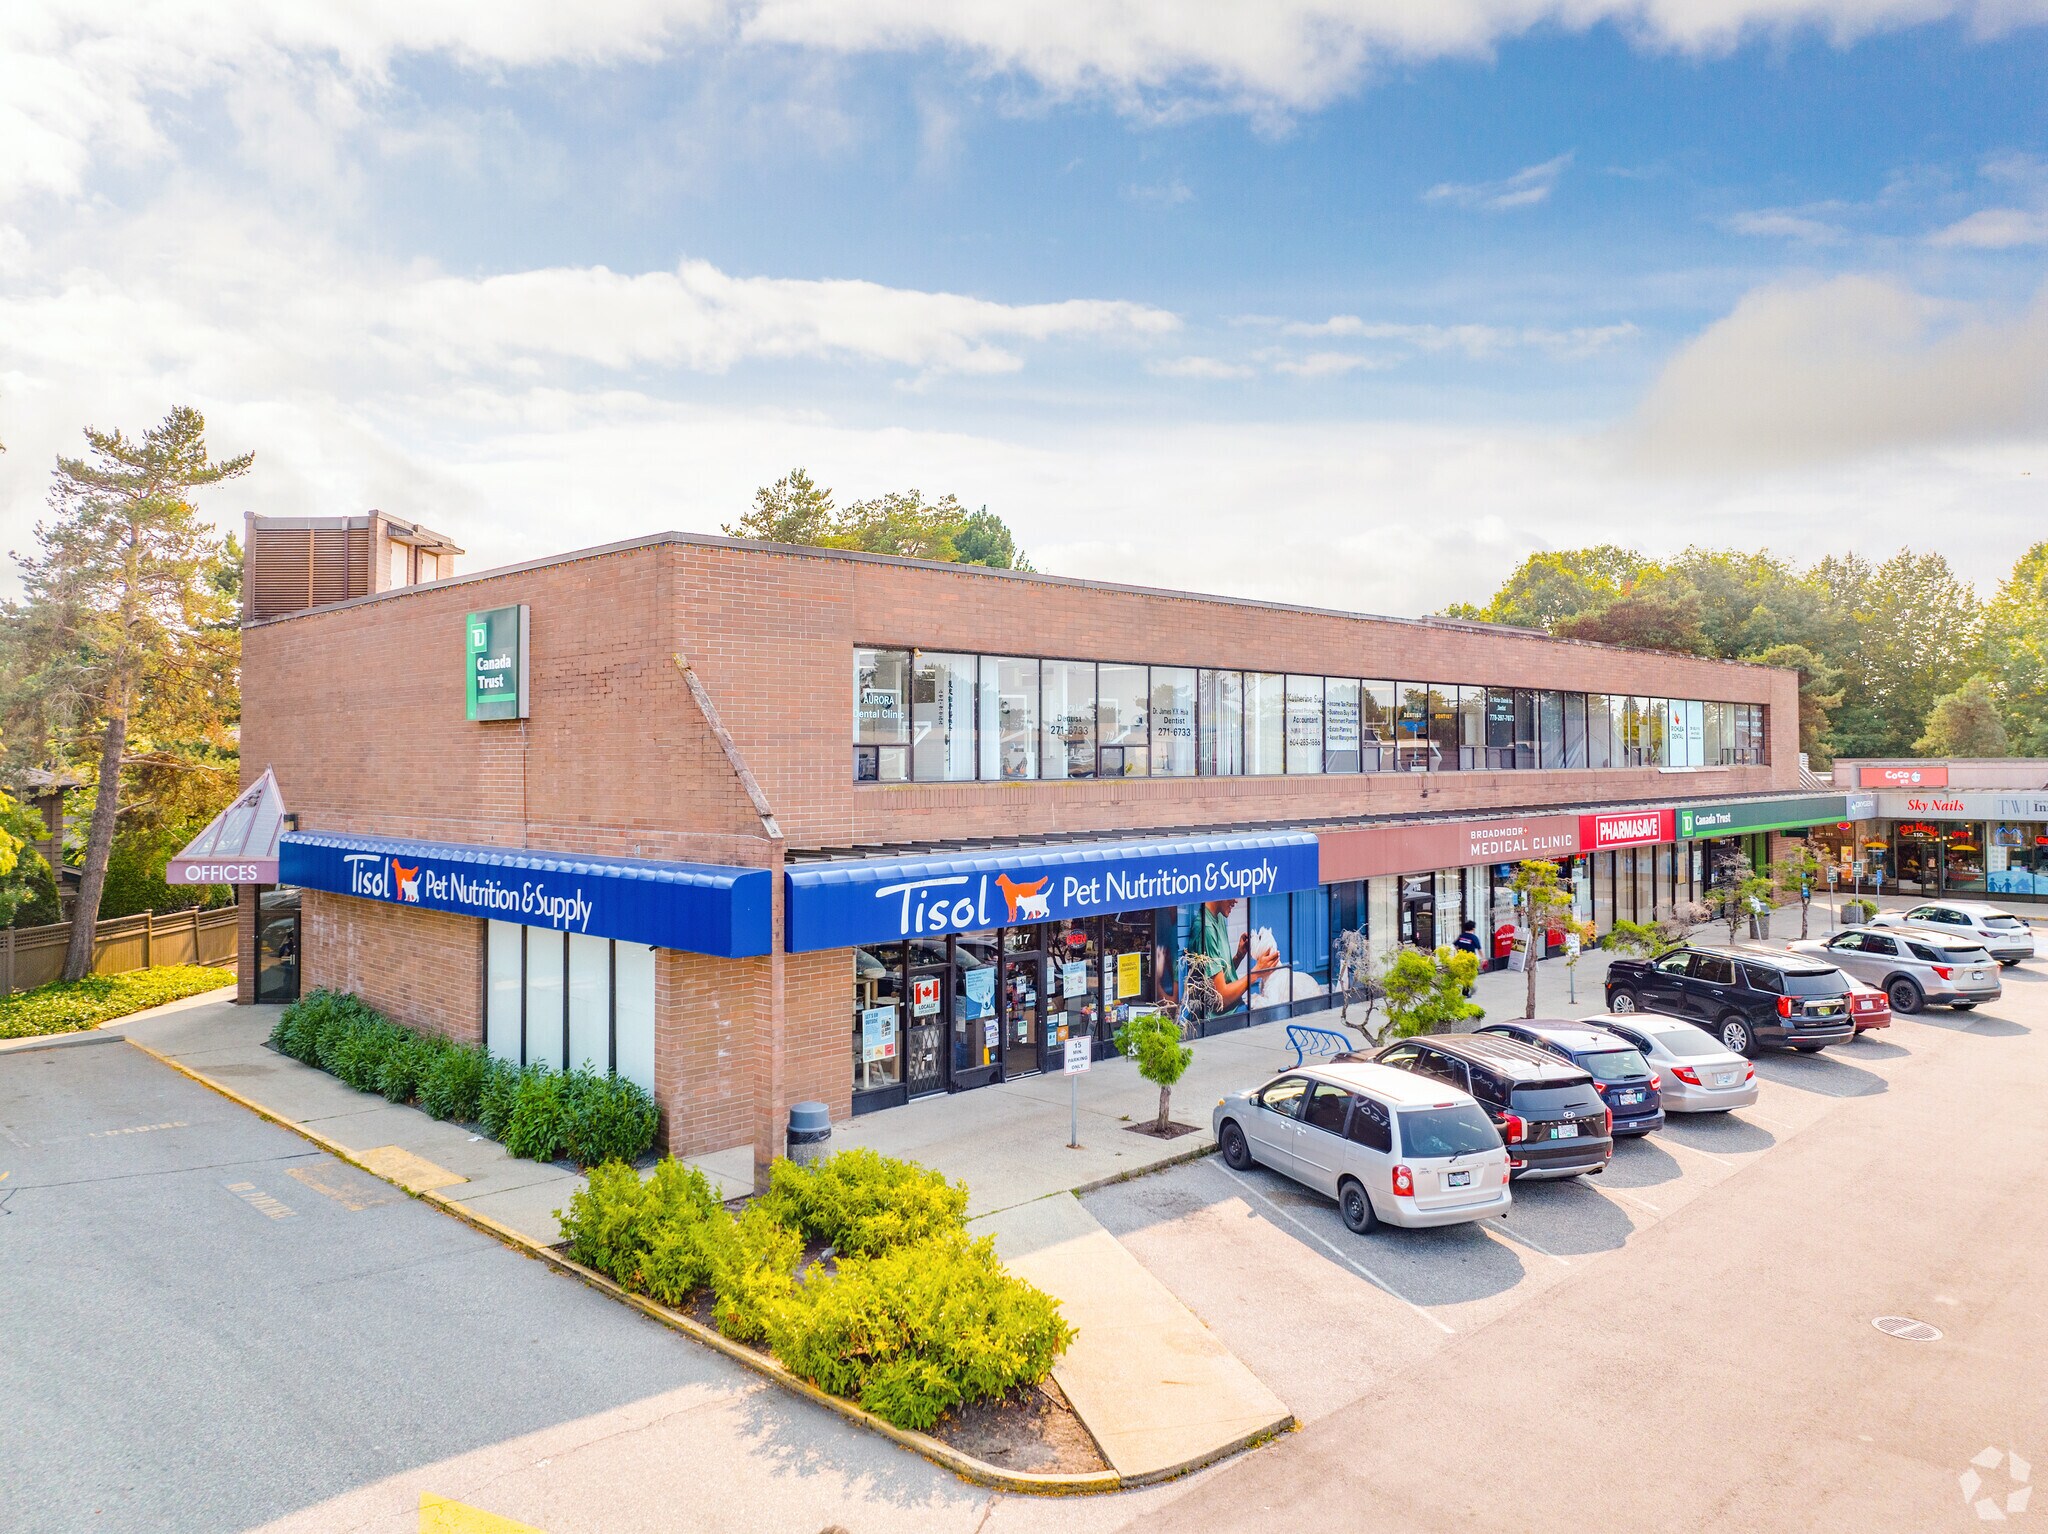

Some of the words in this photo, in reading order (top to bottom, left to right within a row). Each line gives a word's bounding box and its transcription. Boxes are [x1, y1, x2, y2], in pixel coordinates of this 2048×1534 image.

[472, 629, 485, 647] TD
[477, 653, 511, 671] Canada
[477, 673, 504, 689] Trust
[864, 695, 894, 705] AURORA
[853, 709, 880, 718] Dental
[881, 709, 905, 719] Clinic
[1163, 716, 1185, 724] Dentist
[1050, 725, 1089, 736] 271-6733
[1158, 727, 1191, 737] 271-6733
[1885, 770, 1909, 780] CoCo
[1907, 799, 1928, 814] Sky
[1931, 799, 1965, 812] Nails
[2034, 803, 2048, 812] In
[1683, 816, 1693, 832] TD
[1695, 812, 1716, 826] Canada
[1716, 812, 1731, 824] Trust
[1470, 827, 1523, 839] BROADMOOR
[1600, 818, 1657, 842] PHARMASAVE
[1471, 840, 1529, 857] MEDICAL
[1533, 834, 1573, 850] CLINIC
[184, 864, 258, 881] OFFICES
[344, 854, 391, 899] Tisol
[426, 869, 449, 900] Pet
[450, 872, 520, 912] Nutrition
[521, 881, 536, 914] &
[534, 883, 592, 934] Supply
[875, 874, 991, 936] Tisol
[1063, 876, 1101, 908] Pet
[1105, 868, 1202, 902] Nutrition
[1204, 862, 1219, 892] &
[1219, 857, 1278, 896] Supply
[1011, 933, 1032, 946] 117
[1066, 934, 1087, 945] OPEN
[1067, 1055, 1088, 1063] PARKING
